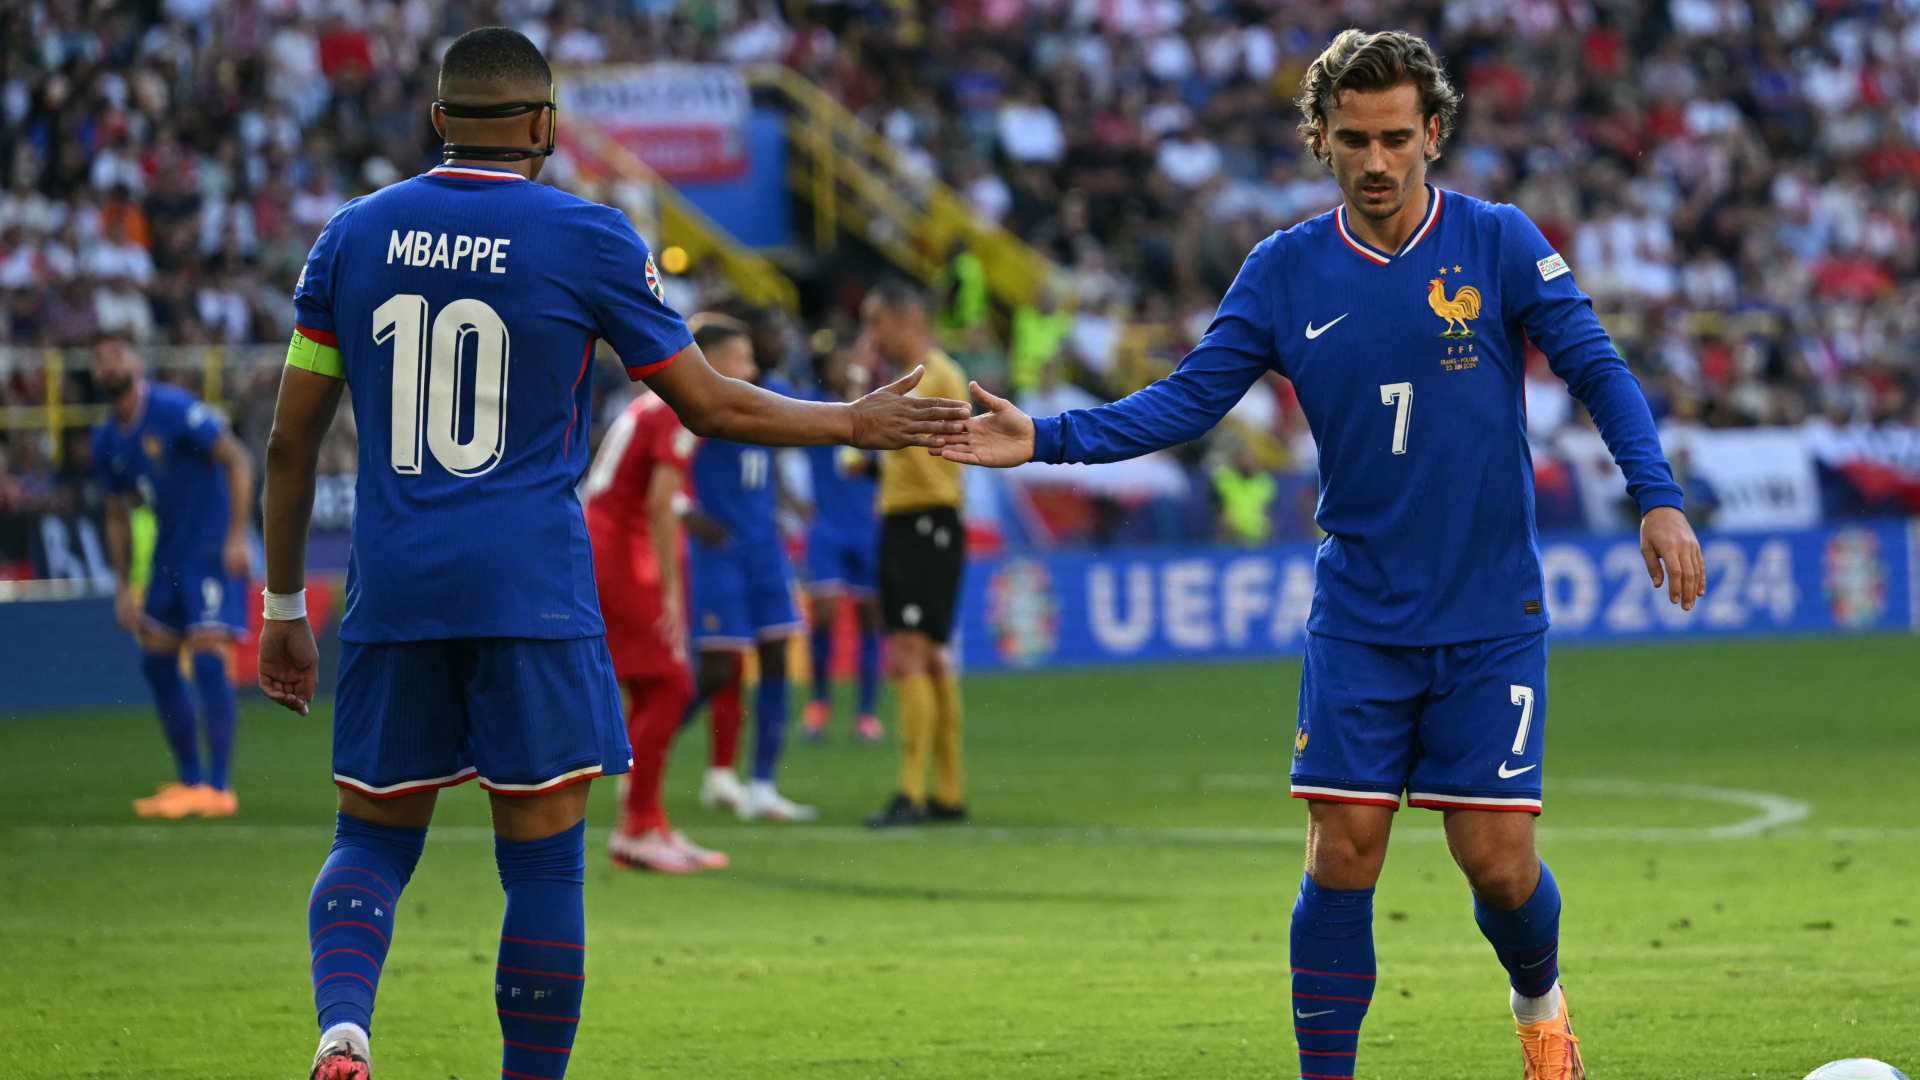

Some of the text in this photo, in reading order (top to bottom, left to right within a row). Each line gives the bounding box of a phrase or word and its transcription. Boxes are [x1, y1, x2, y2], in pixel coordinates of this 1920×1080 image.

[386, 229, 511, 274] MBAPPE
[372, 293, 511, 478] 10
[1379, 381, 1414, 456] 7
[1088, 556, 1317, 652] UEFA
[1510, 684, 1536, 756] 7
